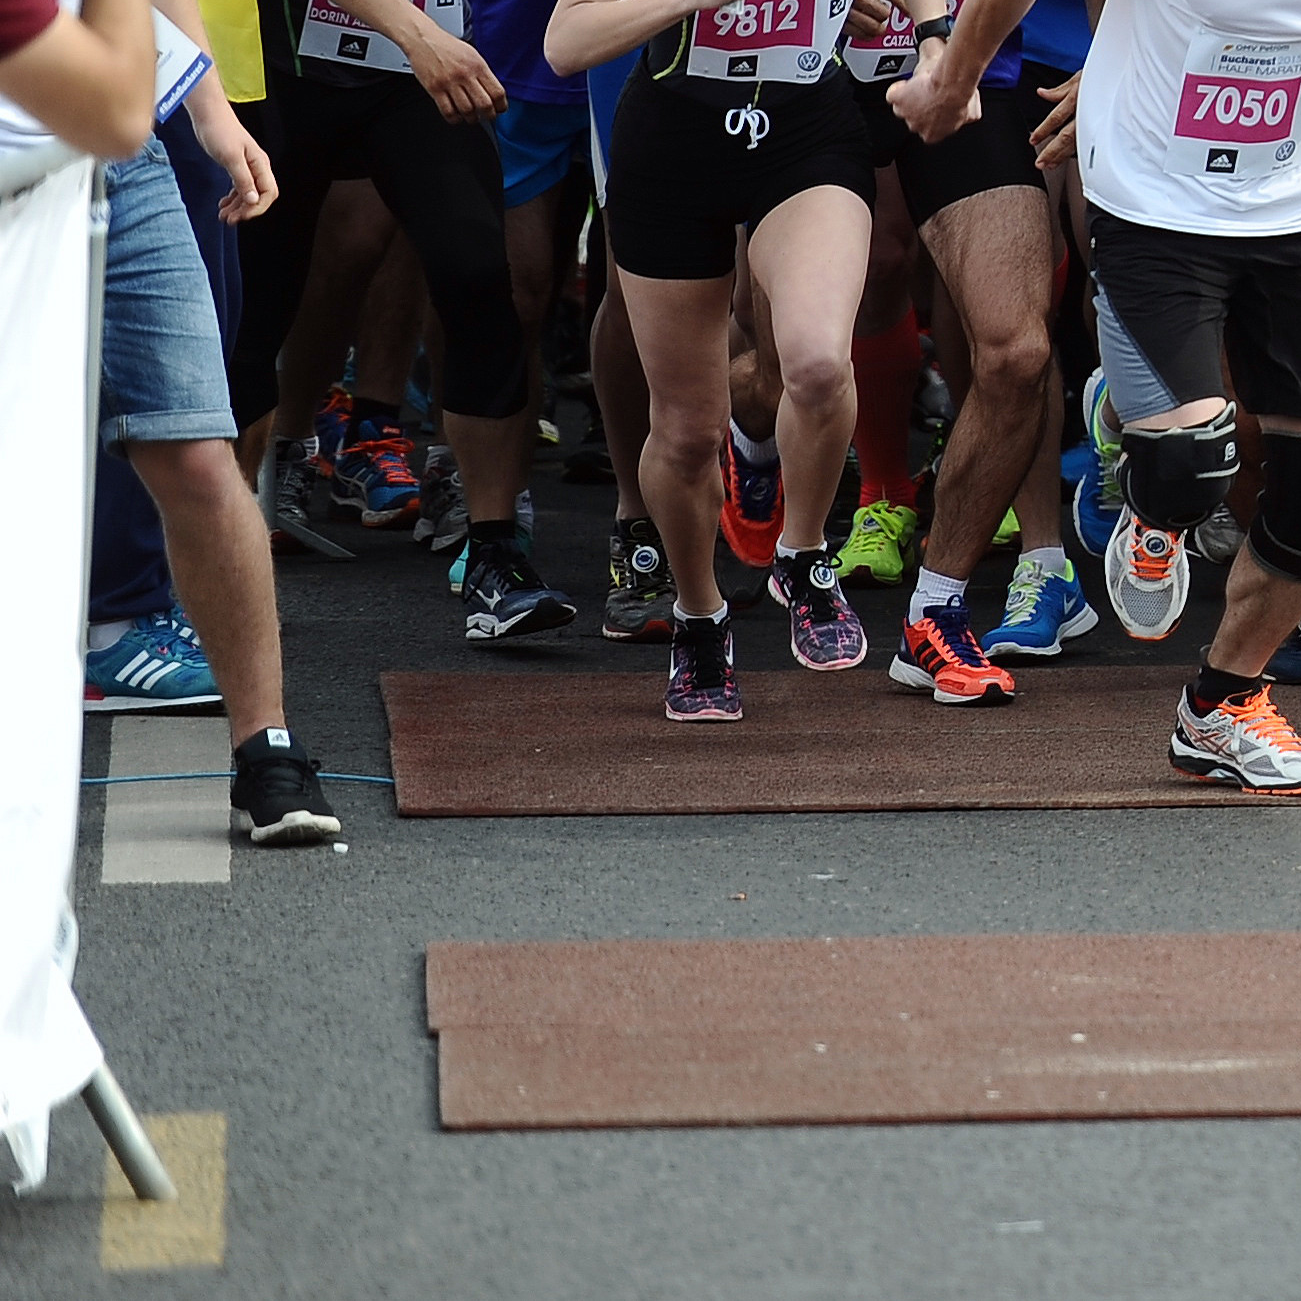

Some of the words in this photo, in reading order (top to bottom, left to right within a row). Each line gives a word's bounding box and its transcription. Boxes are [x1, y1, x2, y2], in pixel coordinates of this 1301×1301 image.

[310, 8, 349, 26] DORIN
[1235, 43, 1258, 52] OMV
[1259, 43, 1290, 52] Petrom
[1220, 54, 1276, 66] Bucharest
[1217, 64, 1254, 74] HALF
[1193, 83, 1289, 126] 7050
